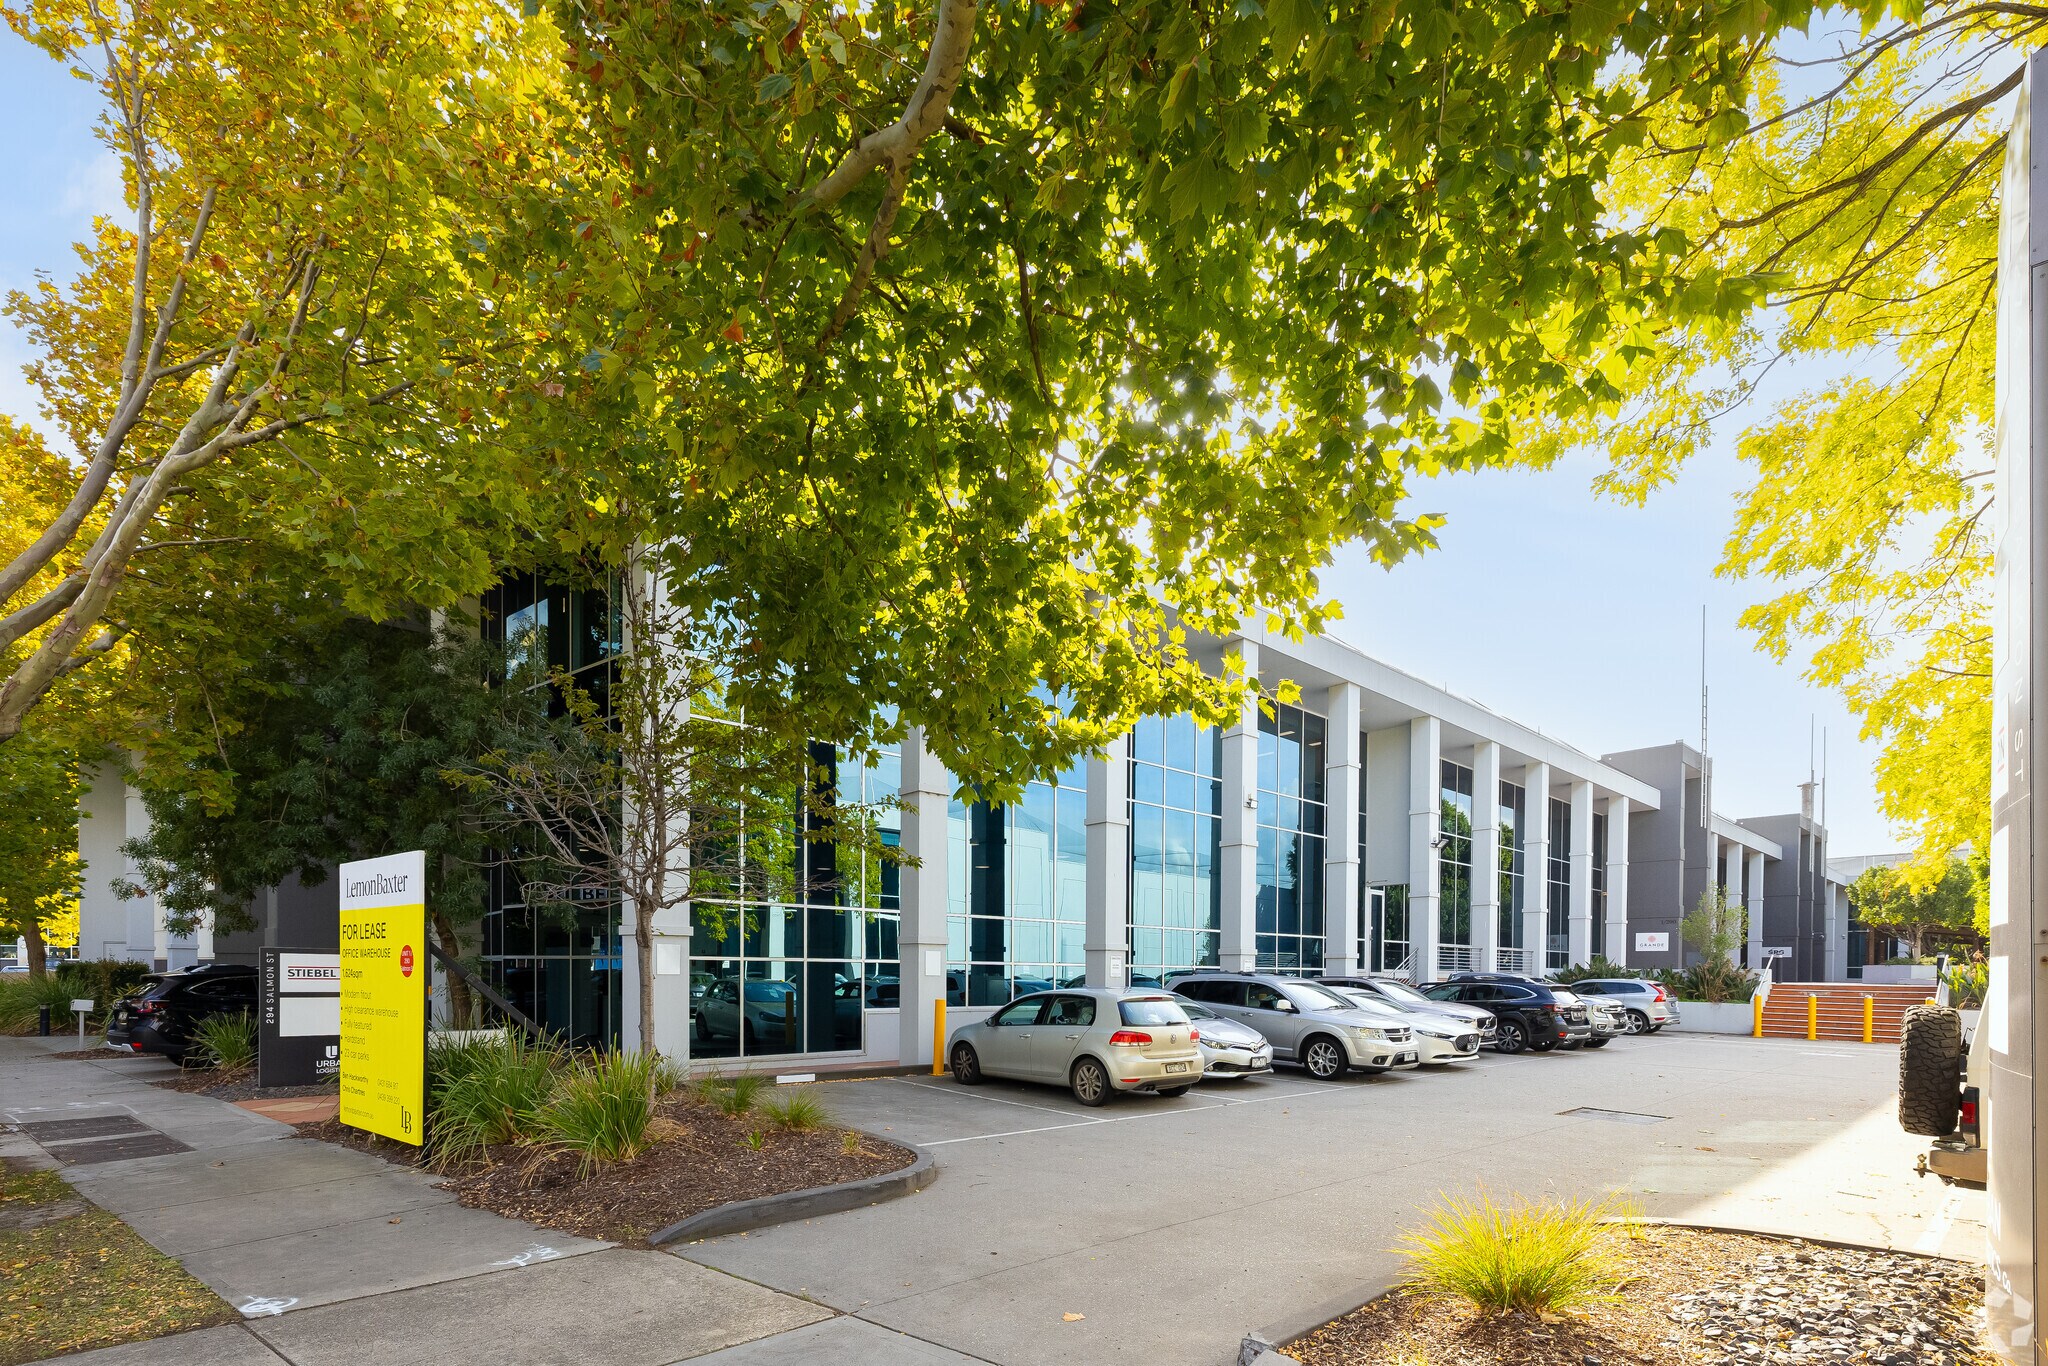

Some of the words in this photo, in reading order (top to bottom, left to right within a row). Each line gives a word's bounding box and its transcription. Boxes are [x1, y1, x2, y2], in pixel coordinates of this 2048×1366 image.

[2013, 728, 2024, 782] ST
[346, 873, 408, 898] LemonBaxter
[342, 924, 358, 940] FOR
[359, 922, 386, 940] LEASE
[266, 952, 275, 963] ST
[342, 948, 359, 958] OFFICE
[359, 947, 391, 959] WAREHOUSE
[288, 969, 337, 978] STIEBEL
[266, 966, 275, 1004] SALMON
[344, 988, 359, 999] Modern
[266, 1007, 275, 1024] 294
[354, 1006, 374, 1016] clearance
[375, 1007, 399, 1018] warehouse
[357, 1050, 369, 1062] parks
